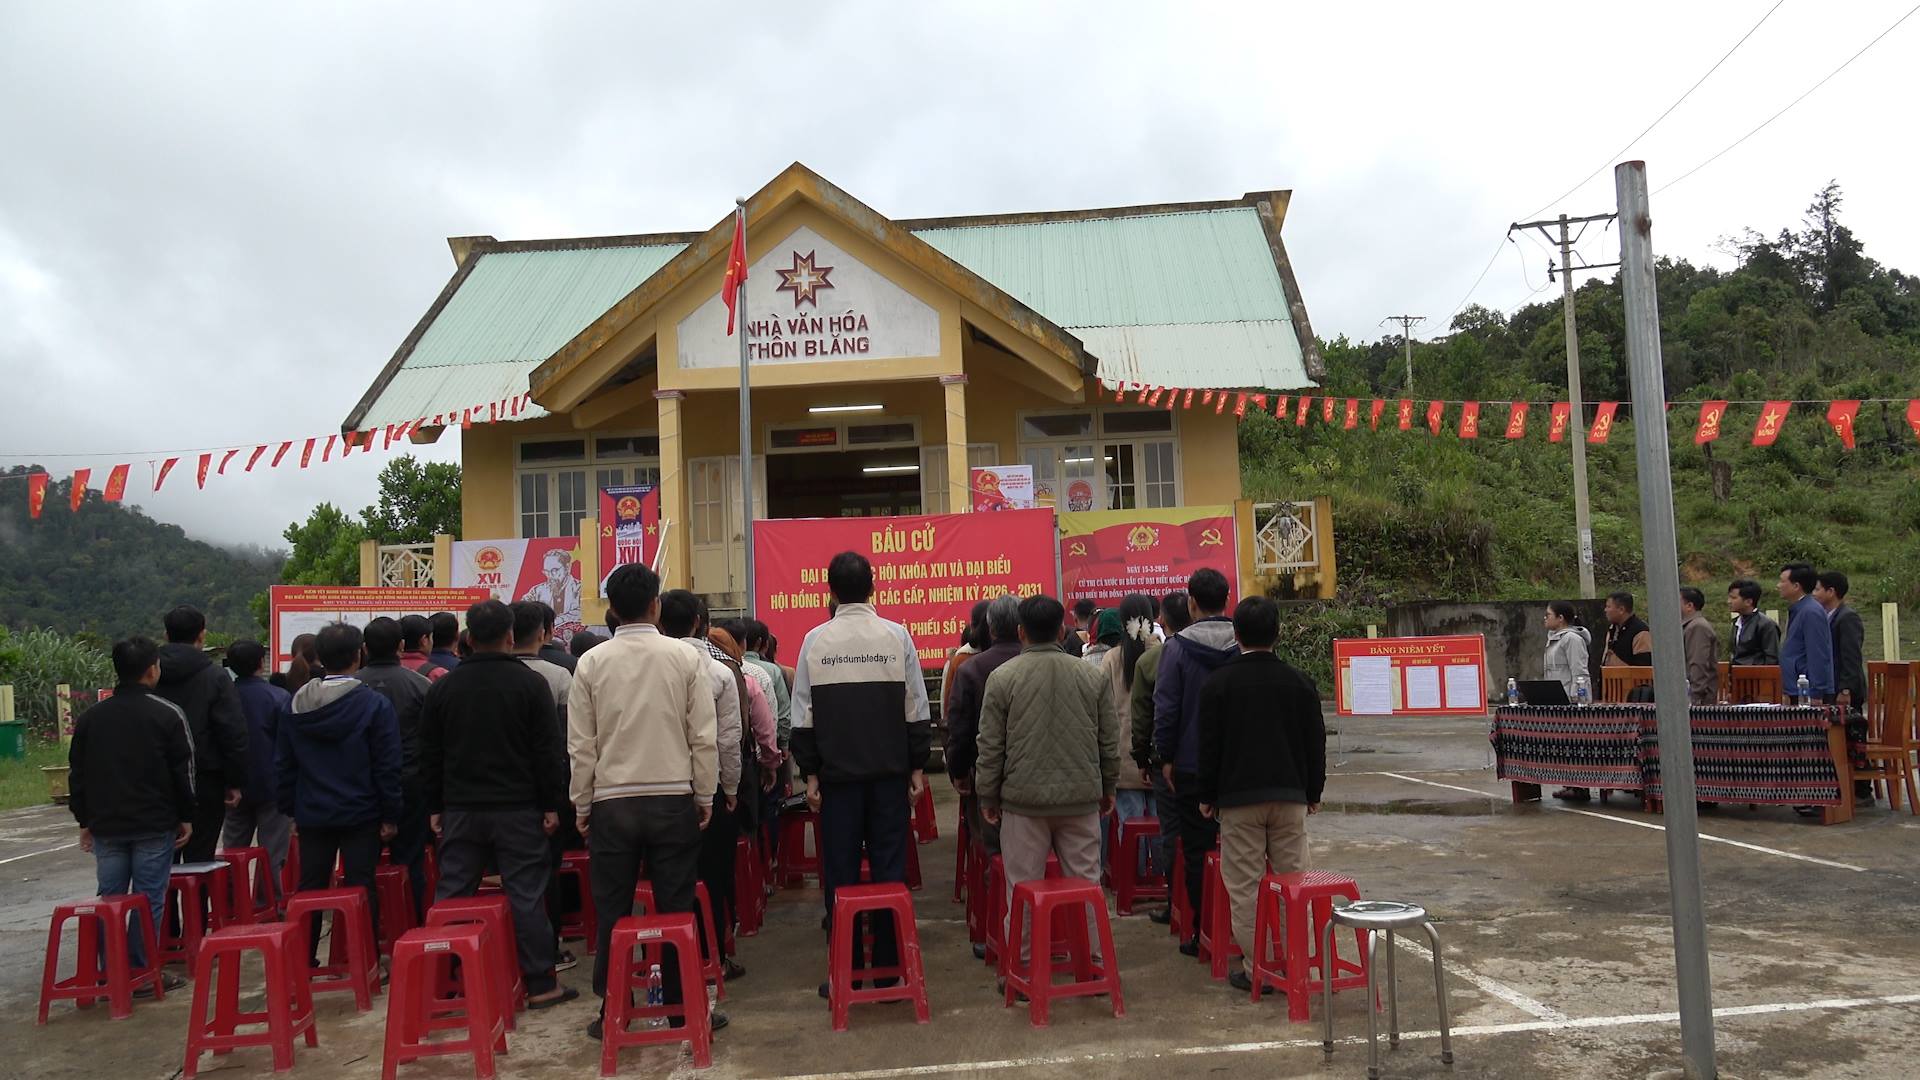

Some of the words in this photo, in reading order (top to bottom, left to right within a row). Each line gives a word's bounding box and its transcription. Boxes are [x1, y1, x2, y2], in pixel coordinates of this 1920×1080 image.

[747, 313, 782, 337] NHÀ
[787, 312, 823, 335] VĂN
[829, 309, 869, 333] HÓA
[748, 335, 797, 360] THÔN
[805, 332, 869, 356] BLĂNG
[871, 523, 907, 554] BẦU
[911, 521, 936, 552] CỬ
[477, 573, 501, 584] XVI
[801, 568, 819, 587] ĐẠI
[879, 562, 897, 584] HỘI
[899, 561, 928, 580] KHÓA
[930, 563, 948, 578] XVI
[950, 559, 964, 577] VÀ
[966, 560, 985, 579] ĐẠI
[987, 553, 1012, 575] BIỂU
[770, 592, 789, 613] HỘI
[791, 588, 820, 609] ĐỒNG
[880, 587, 901, 606] CÁC
[903, 584, 926, 605] CẤP,
[928, 584, 963, 605] NHIỆM
[966, 583, 980, 601] KỲ
[982, 584, 1008, 600] 2026
[1018, 583, 1043, 598] 2031
[910, 617, 941, 636] PHIẾU
[943, 615, 957, 634] SỐ
[1370, 646, 1397, 655] BẢNG
[1399, 644, 1424, 654] NIÊM
[1426, 643, 1446, 654] YẾT
